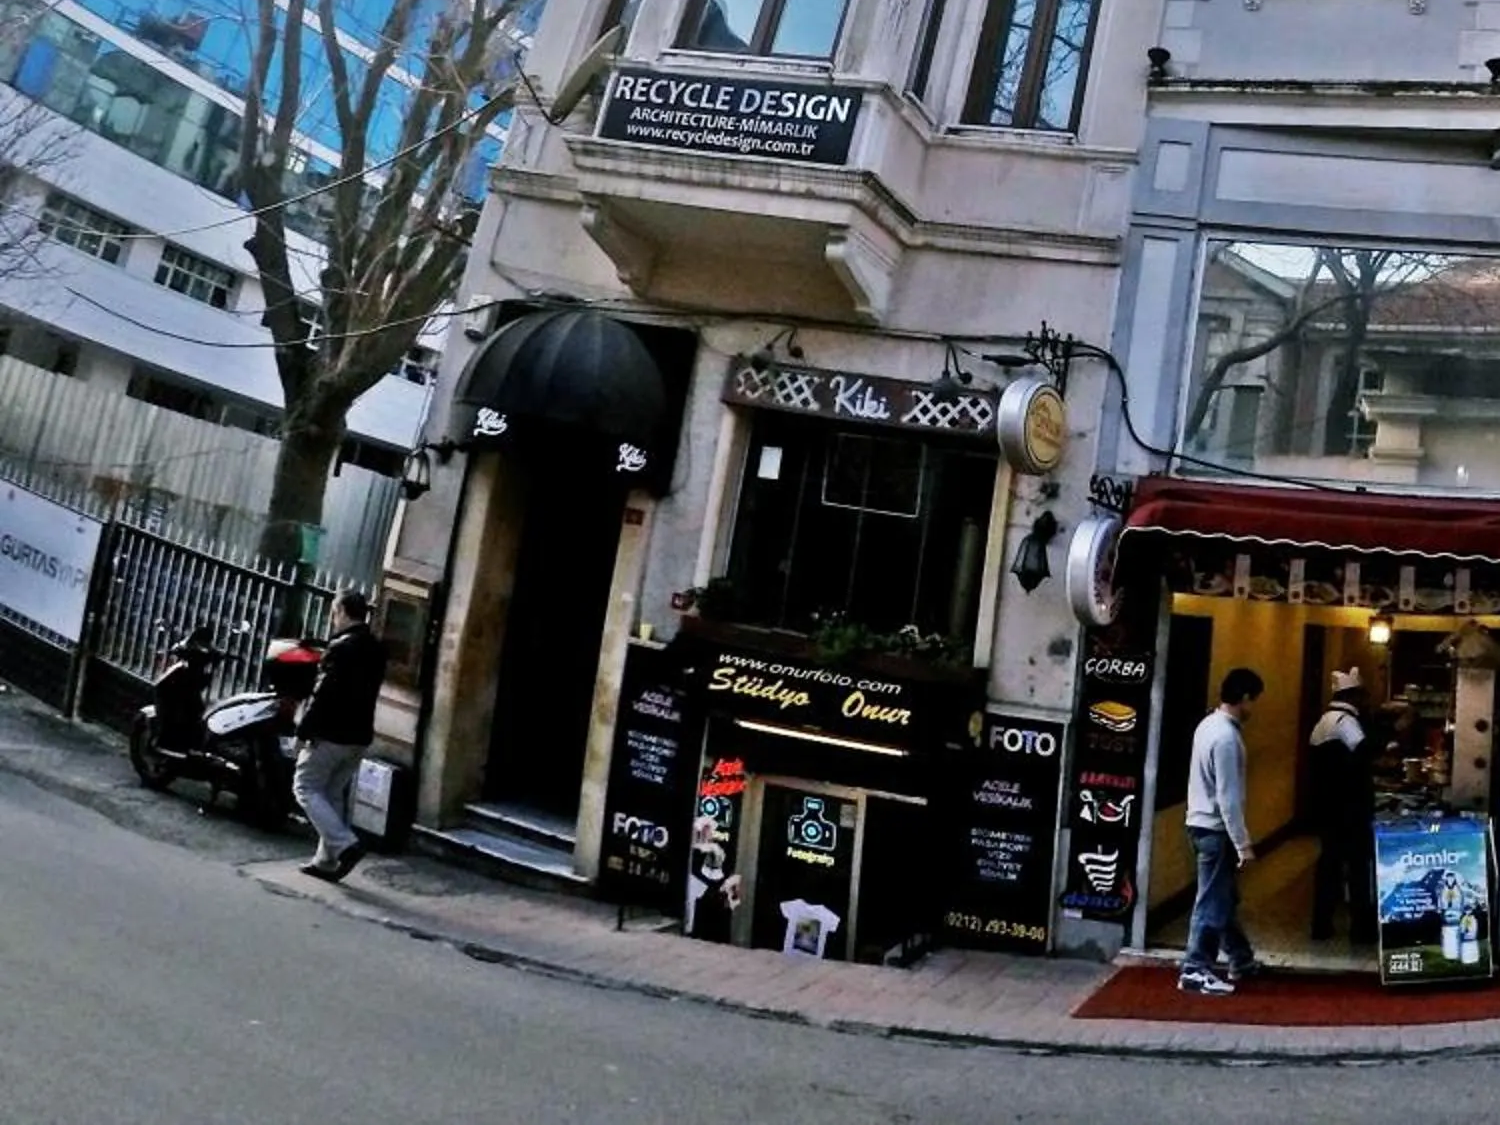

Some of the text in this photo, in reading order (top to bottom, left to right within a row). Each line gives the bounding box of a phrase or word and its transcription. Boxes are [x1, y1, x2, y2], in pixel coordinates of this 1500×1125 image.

[615, 75, 851, 123] RECYCLE DESIGN
[626, 123, 815, 156] www.recycledesign.com.tr
[829, 375, 891, 420] Kiki
[719, 653, 901, 695] www.onurfoto.com
[1084, 658, 1146, 677] ÇORBA
[708, 667, 912, 725] Stüdyo Onur
[989, 725, 1056, 756] FOTO
[612, 811, 669, 849] FOTO
[1401, 850, 1460, 866] damla
